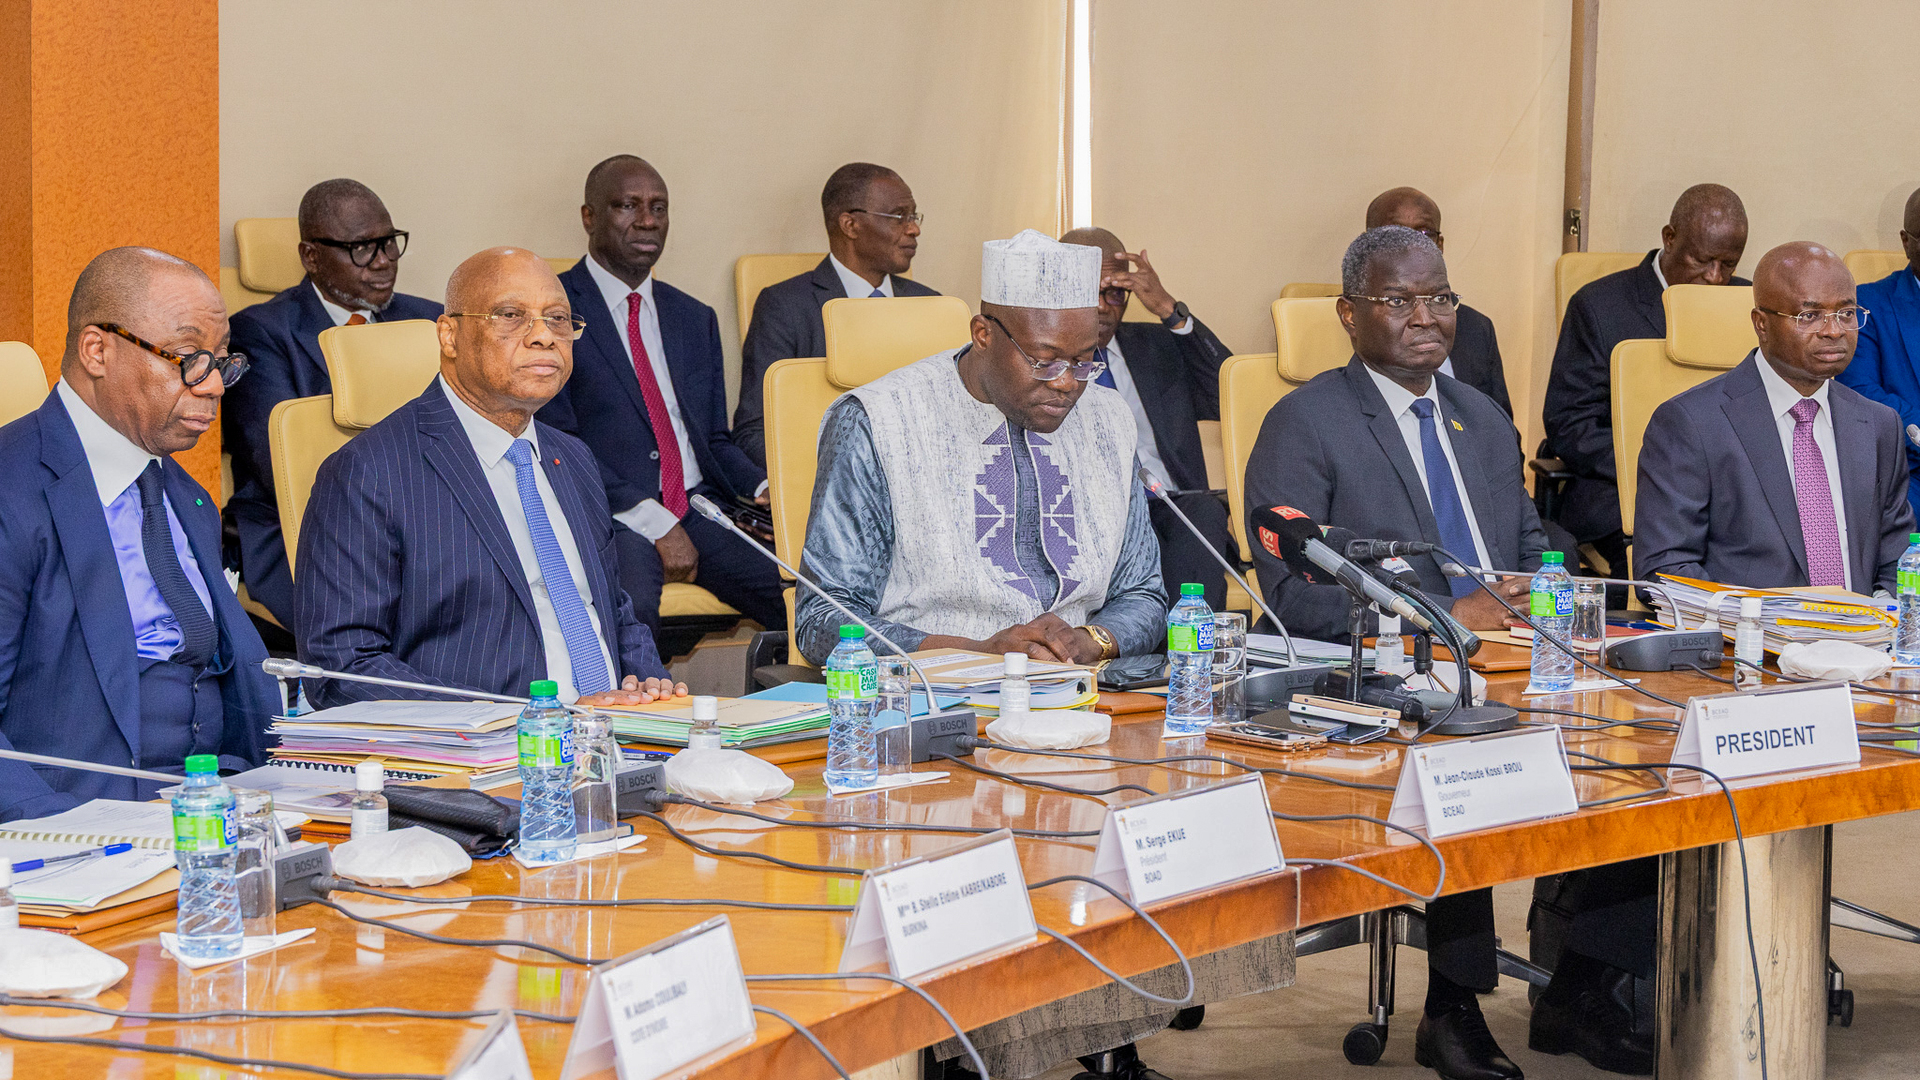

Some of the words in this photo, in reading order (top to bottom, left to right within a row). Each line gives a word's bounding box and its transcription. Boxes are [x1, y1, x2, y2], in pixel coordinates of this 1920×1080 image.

[1682, 637, 1711, 647] BOSCH
[940, 719, 967, 732] BOSCH
[1715, 725, 1816, 755] PRESIDENT
[628, 773, 657, 788] BOSCH
[1433, 775, 1444, 786] M.
[1444, 769, 1484, 785] Jean-Claude
[1504, 761, 1523, 774] BROU
[1437, 789, 1472, 802] Gouverneur
[1442, 804, 1466, 818] BCEAO
[1135, 838, 1146, 851] M.
[1145, 835, 1167, 848] Serge
[1167, 827, 1187, 843] EKUE
[294, 856, 323, 873] BOSCH
[1144, 870, 1162, 884] BOAD
